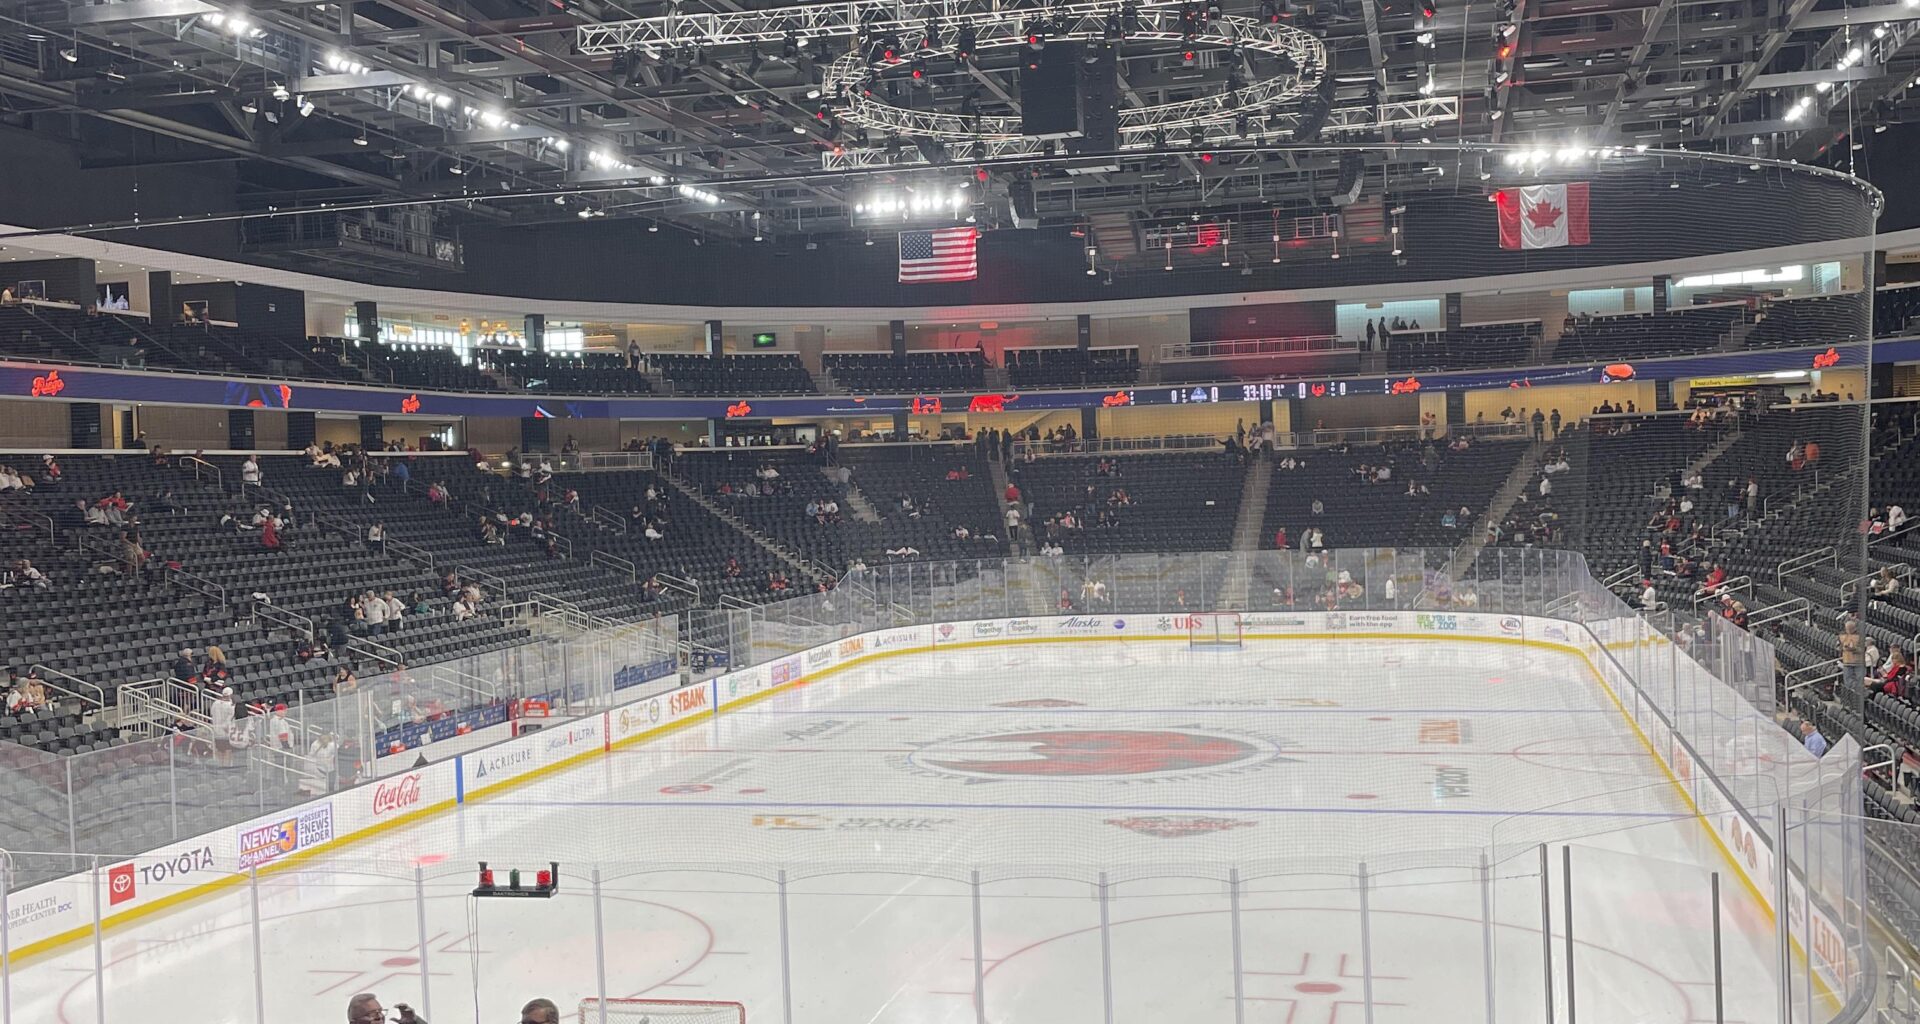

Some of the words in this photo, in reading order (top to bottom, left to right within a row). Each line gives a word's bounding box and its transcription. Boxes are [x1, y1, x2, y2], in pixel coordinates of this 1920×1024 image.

[1243, 384, 1272, 400] 33:16
[1059, 616, 1101, 629] Alaska
[1174, 617, 1202, 630] UBS
[1417, 621, 1435, 630] THE
[489, 750, 531, 772] ACRISURE
[304, 817, 329, 834] NEWS
[242, 826, 280, 852] NEWS
[300, 829, 330, 848] LEADER
[141, 846, 214, 885] TOYOTA
[239, 845, 280, 868] CHANNEL
[22, 896, 57, 916] HEALTH
[30, 907, 57, 922] CENTER
